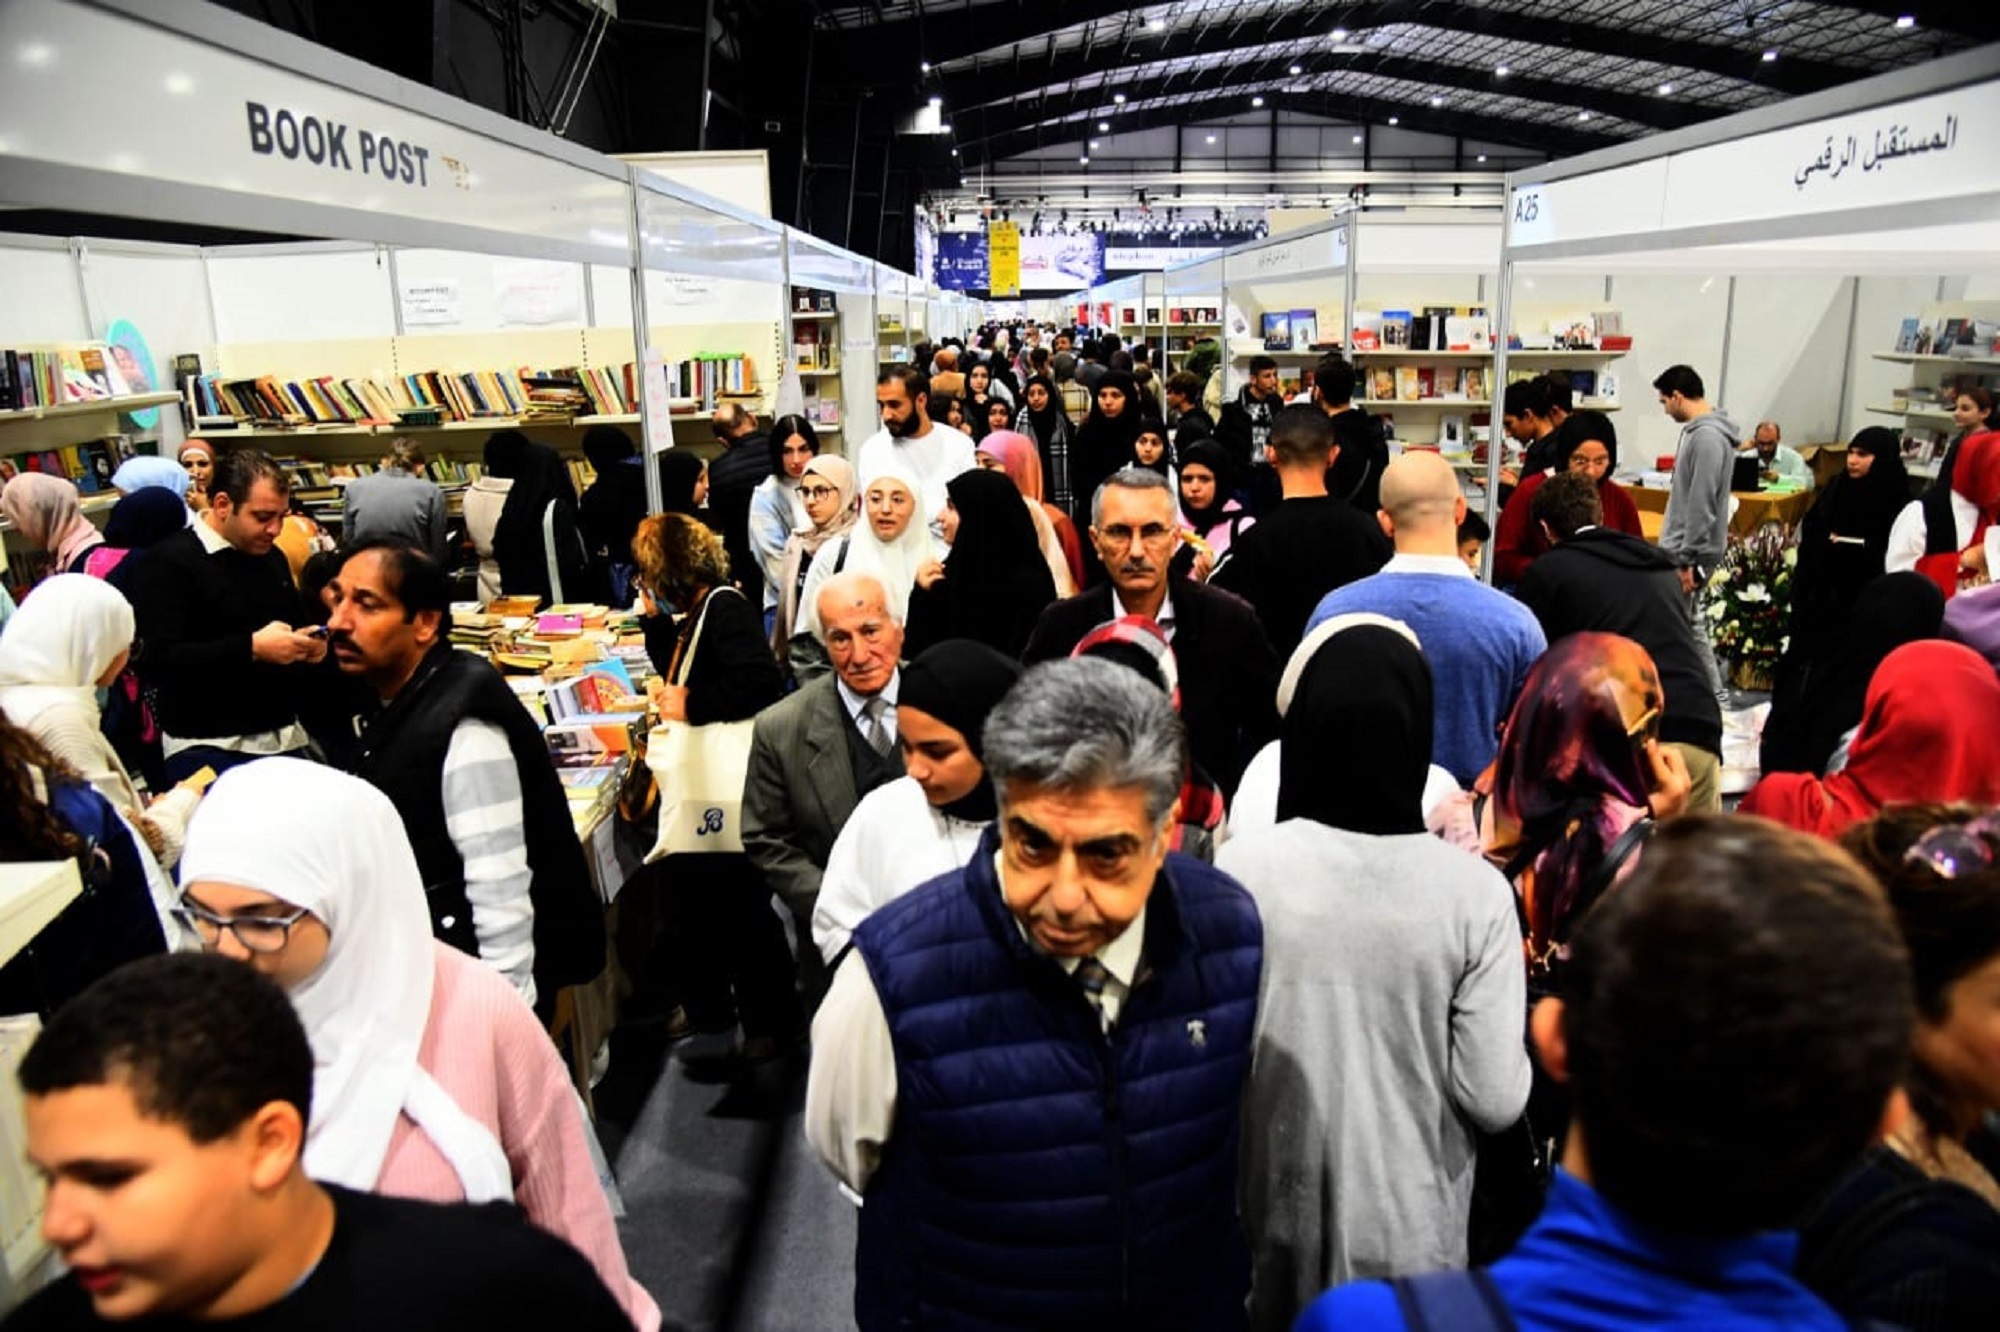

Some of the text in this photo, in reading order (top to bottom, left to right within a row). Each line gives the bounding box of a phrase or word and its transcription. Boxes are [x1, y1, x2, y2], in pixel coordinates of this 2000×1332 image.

[246, 101, 428, 187] BOOK POST
[1794, 114, 1958, 190] المستقبل الرقمي
[1514, 194, 1539, 222] A25
